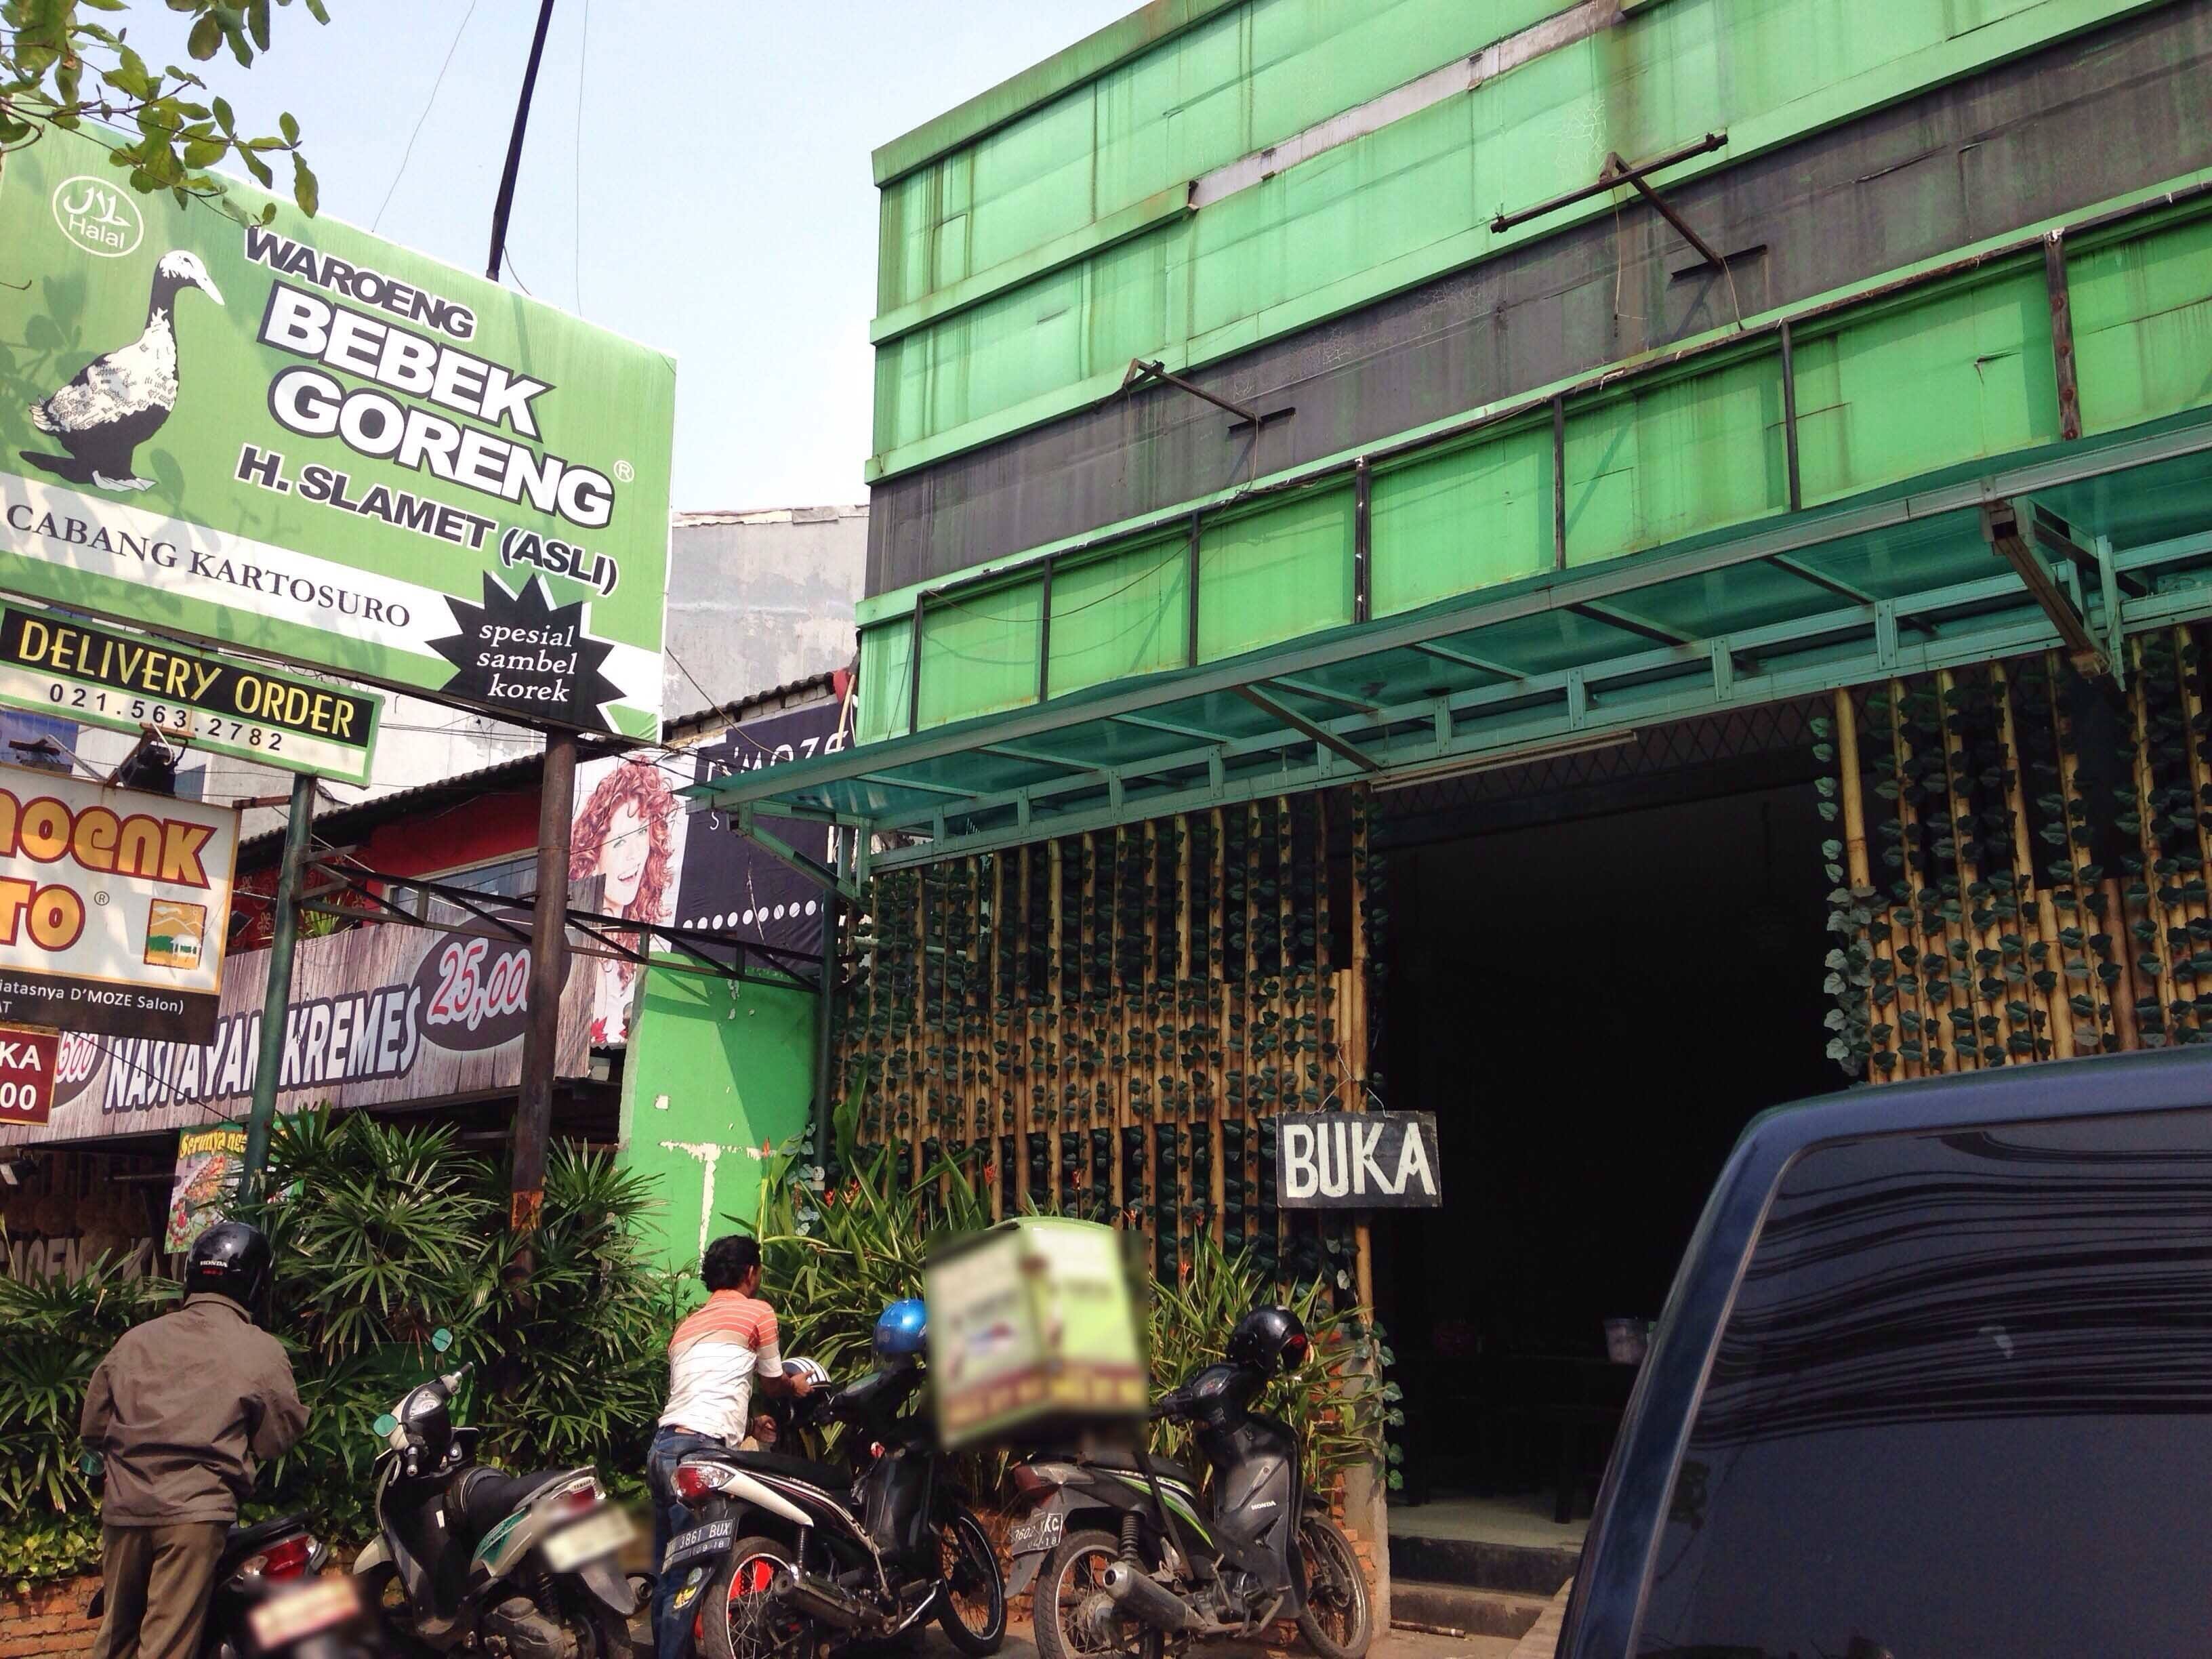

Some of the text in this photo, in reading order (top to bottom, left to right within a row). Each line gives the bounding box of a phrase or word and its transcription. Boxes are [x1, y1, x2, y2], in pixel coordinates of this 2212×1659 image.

[68, 213, 125, 249] Halal
[246, 226, 475, 339] WAROENG
[259, 281, 553, 442] BEBEK
[269, 367, 615, 529] GORENG
[239, 447, 618, 595] H. SLAMET (ASLI)
[7, 504, 411, 628] CABANG KARTOSURO
[476, 649, 577, 674] sambel
[478, 624, 575, 647] spesial
[18, 619, 356, 738] DELIVERY ORDER
[487, 673, 570, 702] korek
[70, 988, 133, 1007] D'MOZE
[137, 996, 184, 1015] Salon)
[104, 1038, 175, 1109] NASI
[280, 986, 421, 1086] KREMES
[1283, 1122, 1437, 1198] BUKA
[200, 1260, 228, 1268] HONDA
[709, 1521, 731, 1538] BUX
[1250, 1500, 1277, 1511] HONDA
